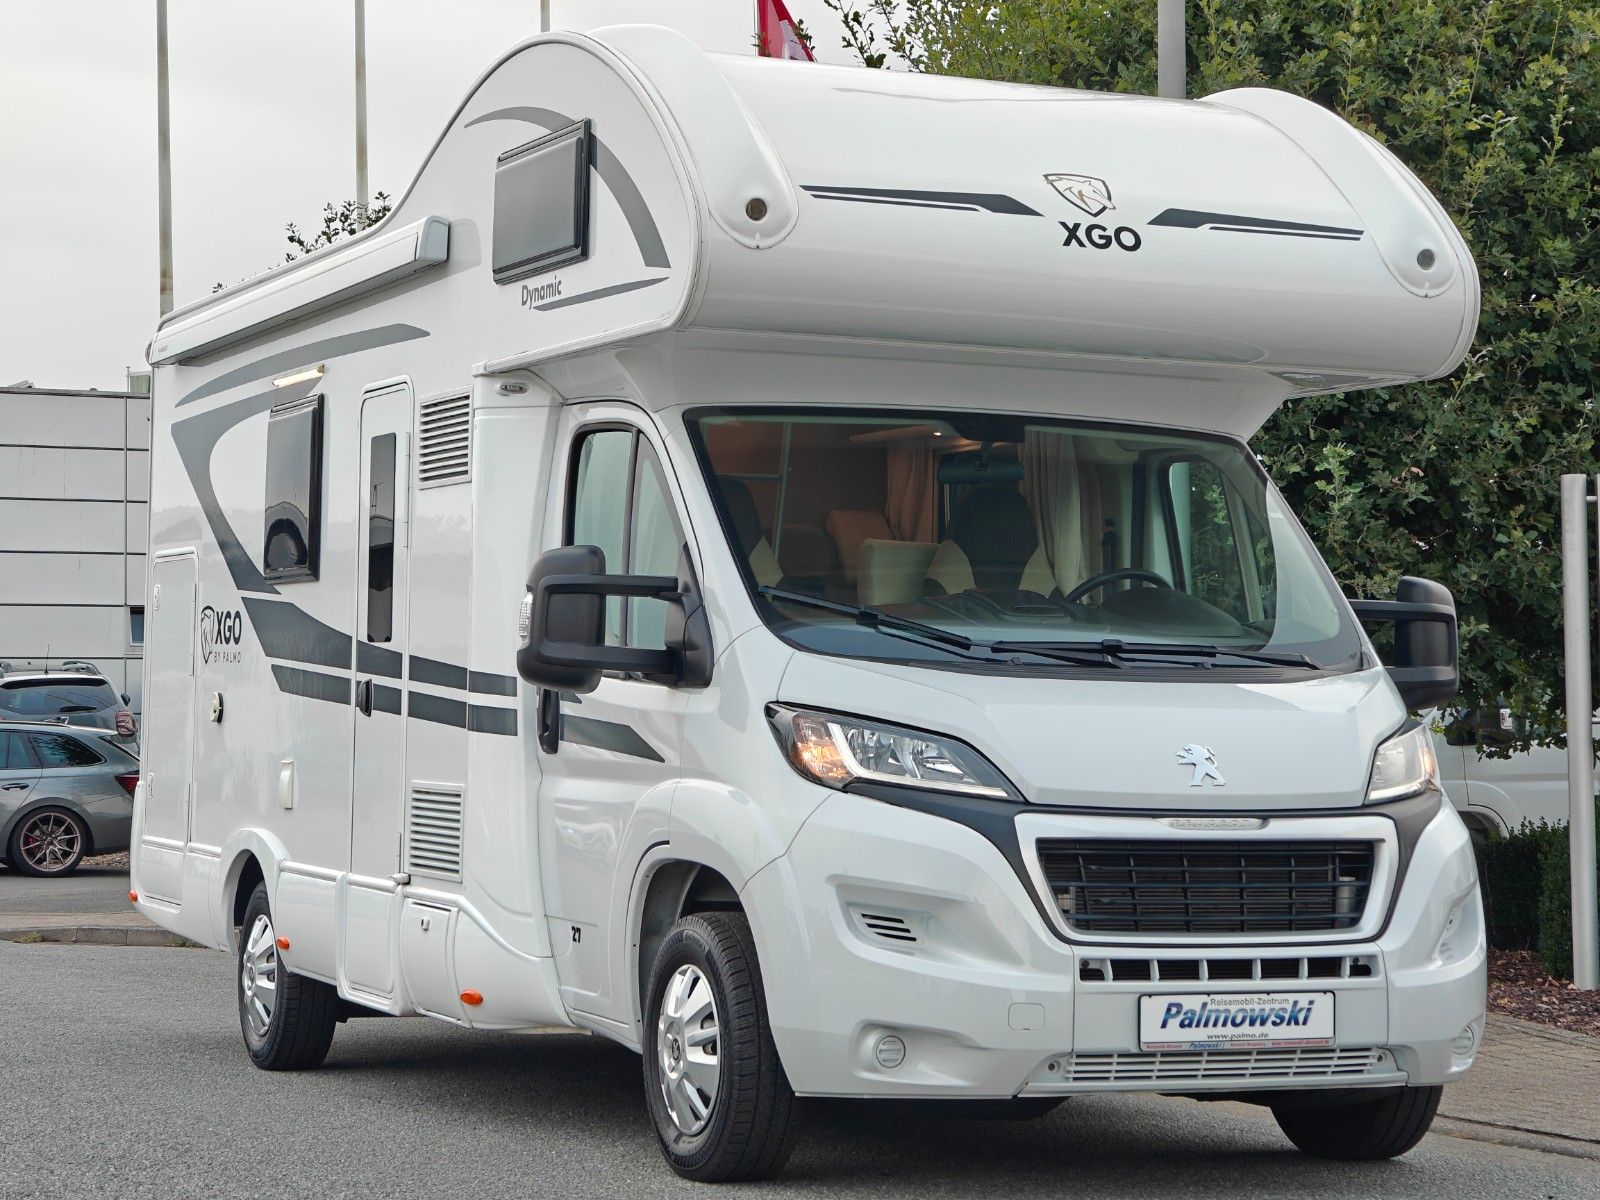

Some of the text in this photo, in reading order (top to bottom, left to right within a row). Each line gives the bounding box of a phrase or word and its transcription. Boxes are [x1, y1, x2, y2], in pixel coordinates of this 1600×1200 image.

[1058, 221, 1142, 252] XGO
[521, 275, 562, 310] Dynamic
[215, 610, 242, 645] XGO
[1160, 1000, 1315, 1029] Palmowski
[1210, 998, 1290, 1006] Reisemobil-Zentrum
[1207, 1032, 1269, 1041] www.palmo.de
